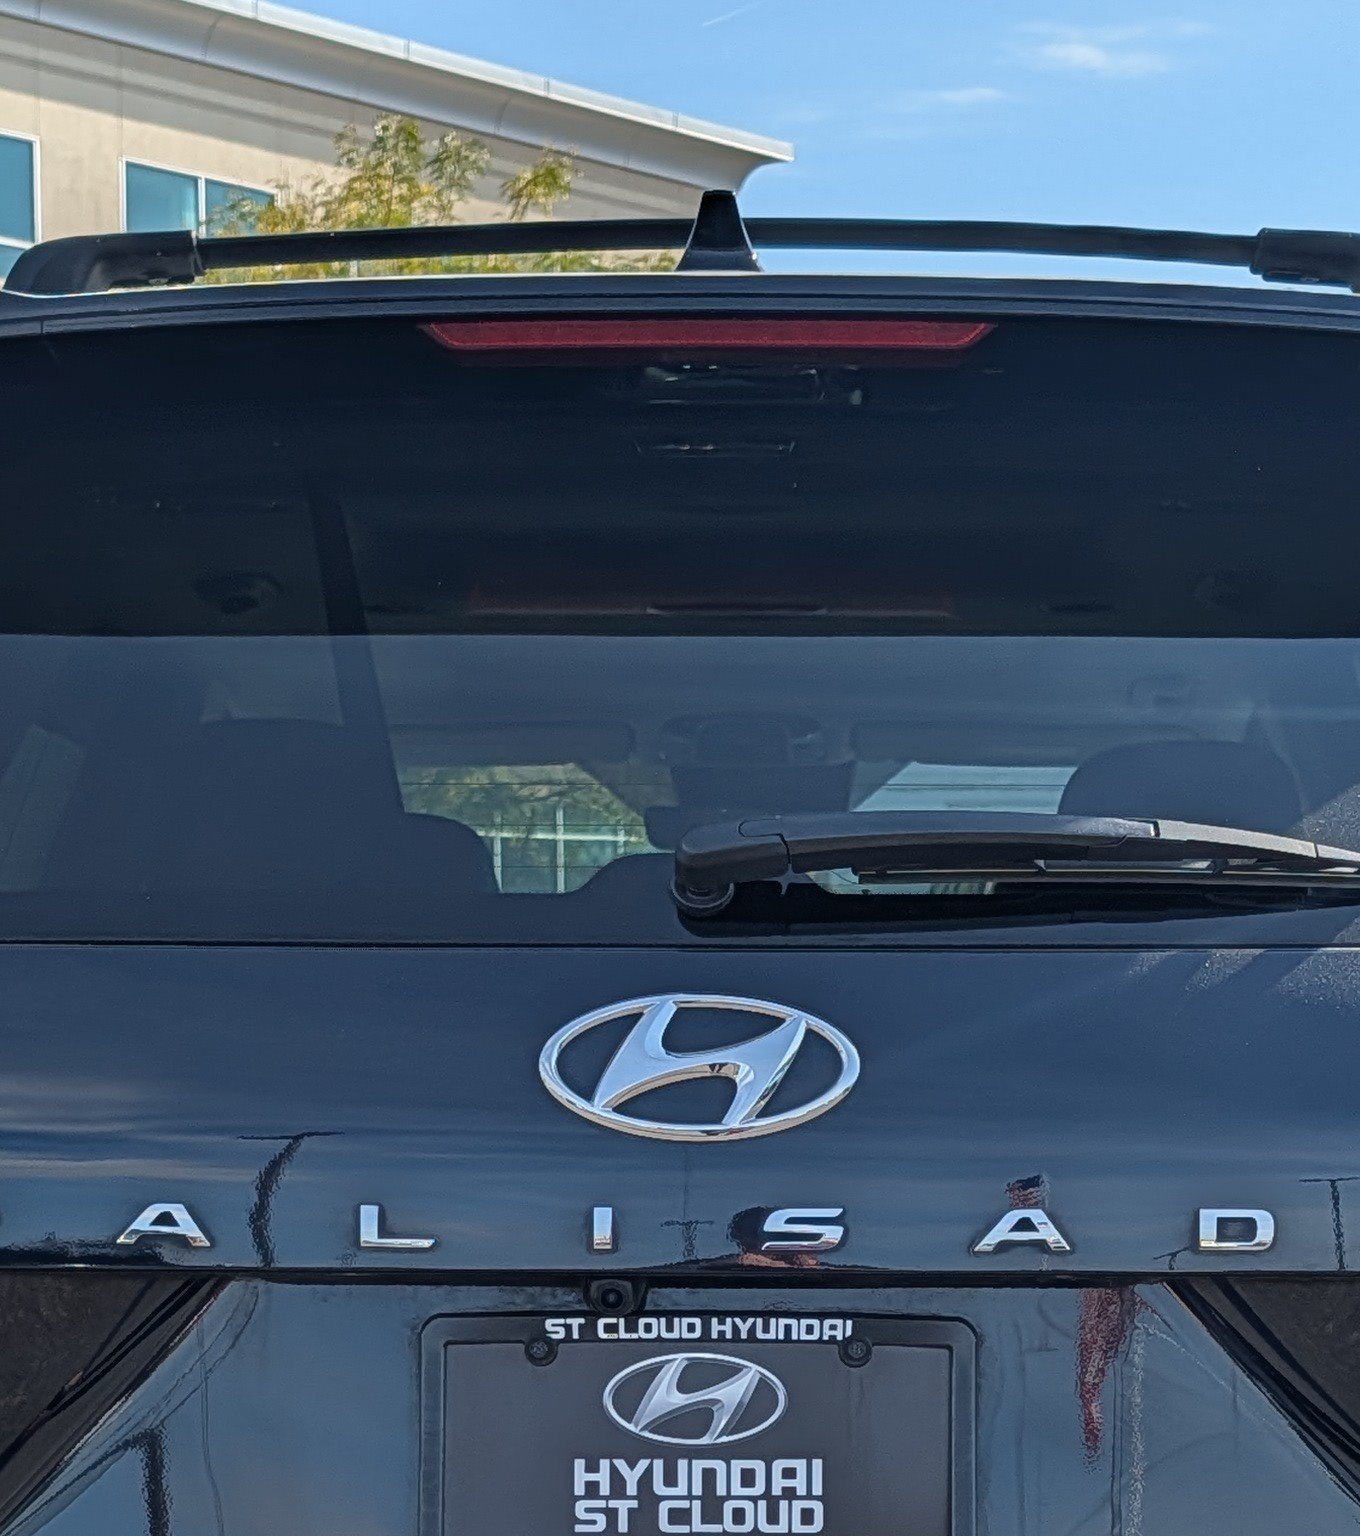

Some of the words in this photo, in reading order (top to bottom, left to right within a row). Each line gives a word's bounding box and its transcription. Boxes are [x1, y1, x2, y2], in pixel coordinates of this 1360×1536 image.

[544, 1317, 586, 1339] ST
[596, 1317, 702, 1340] CLOUD
[710, 1317, 853, 1341] HYUNDAI
[573, 1458, 824, 1497] HYUNDAI
[573, 1499, 639, 1534] ST
[658, 1499, 825, 1534] CLOUD
